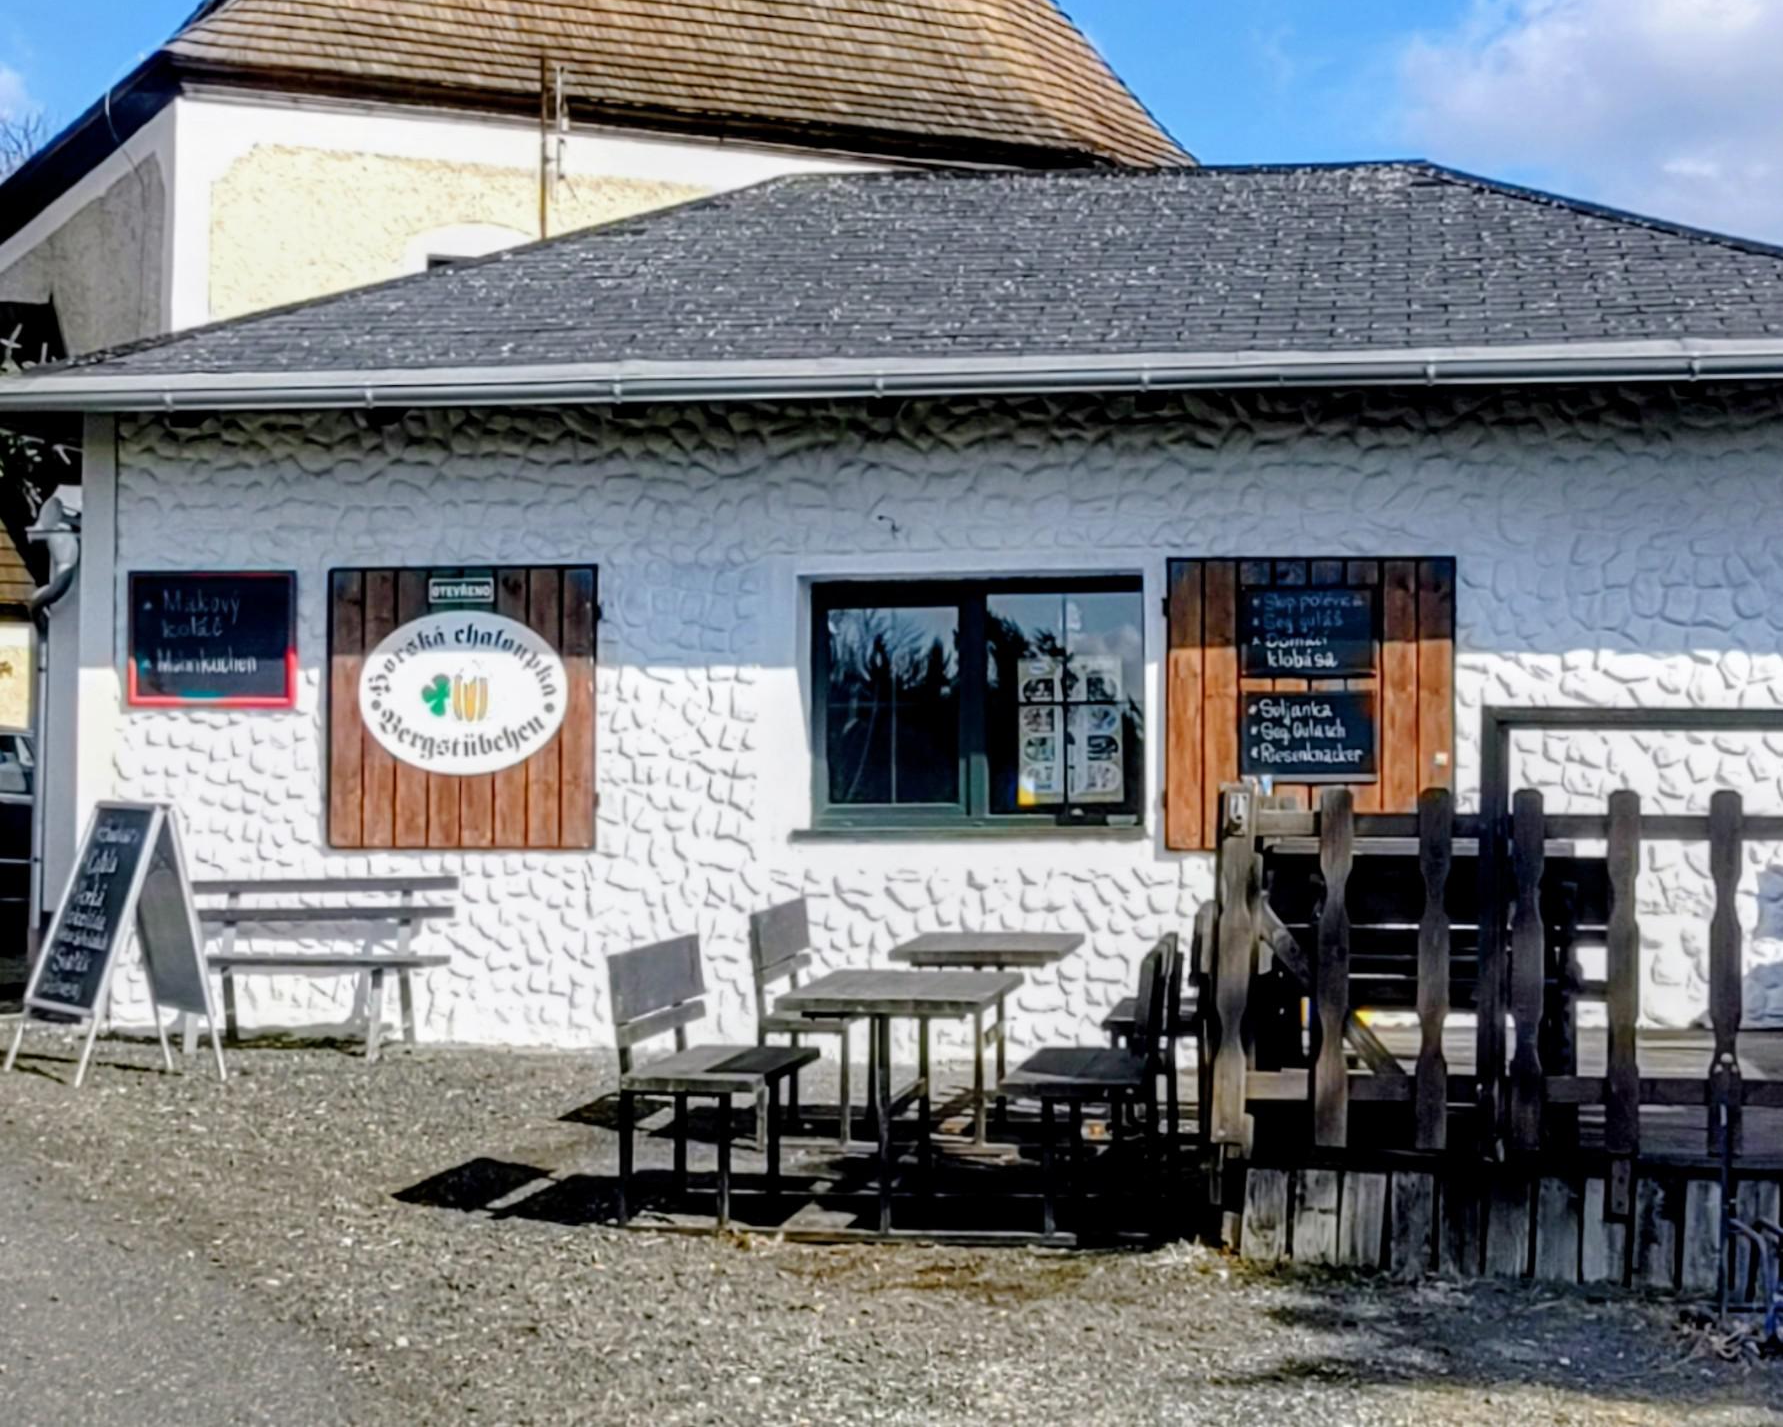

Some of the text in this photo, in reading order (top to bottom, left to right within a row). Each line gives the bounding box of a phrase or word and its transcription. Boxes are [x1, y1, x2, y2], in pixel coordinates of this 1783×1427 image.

[431, 583, 491, 598] OTEVŘENO
[368, 625, 447, 697] Horská
[1266, 648, 1339, 669] klobása
[1259, 697, 1334, 727] Soljanka
[378, 707, 546, 760] Bergstübchen
[1260, 740, 1364, 764] Riesenknacker
